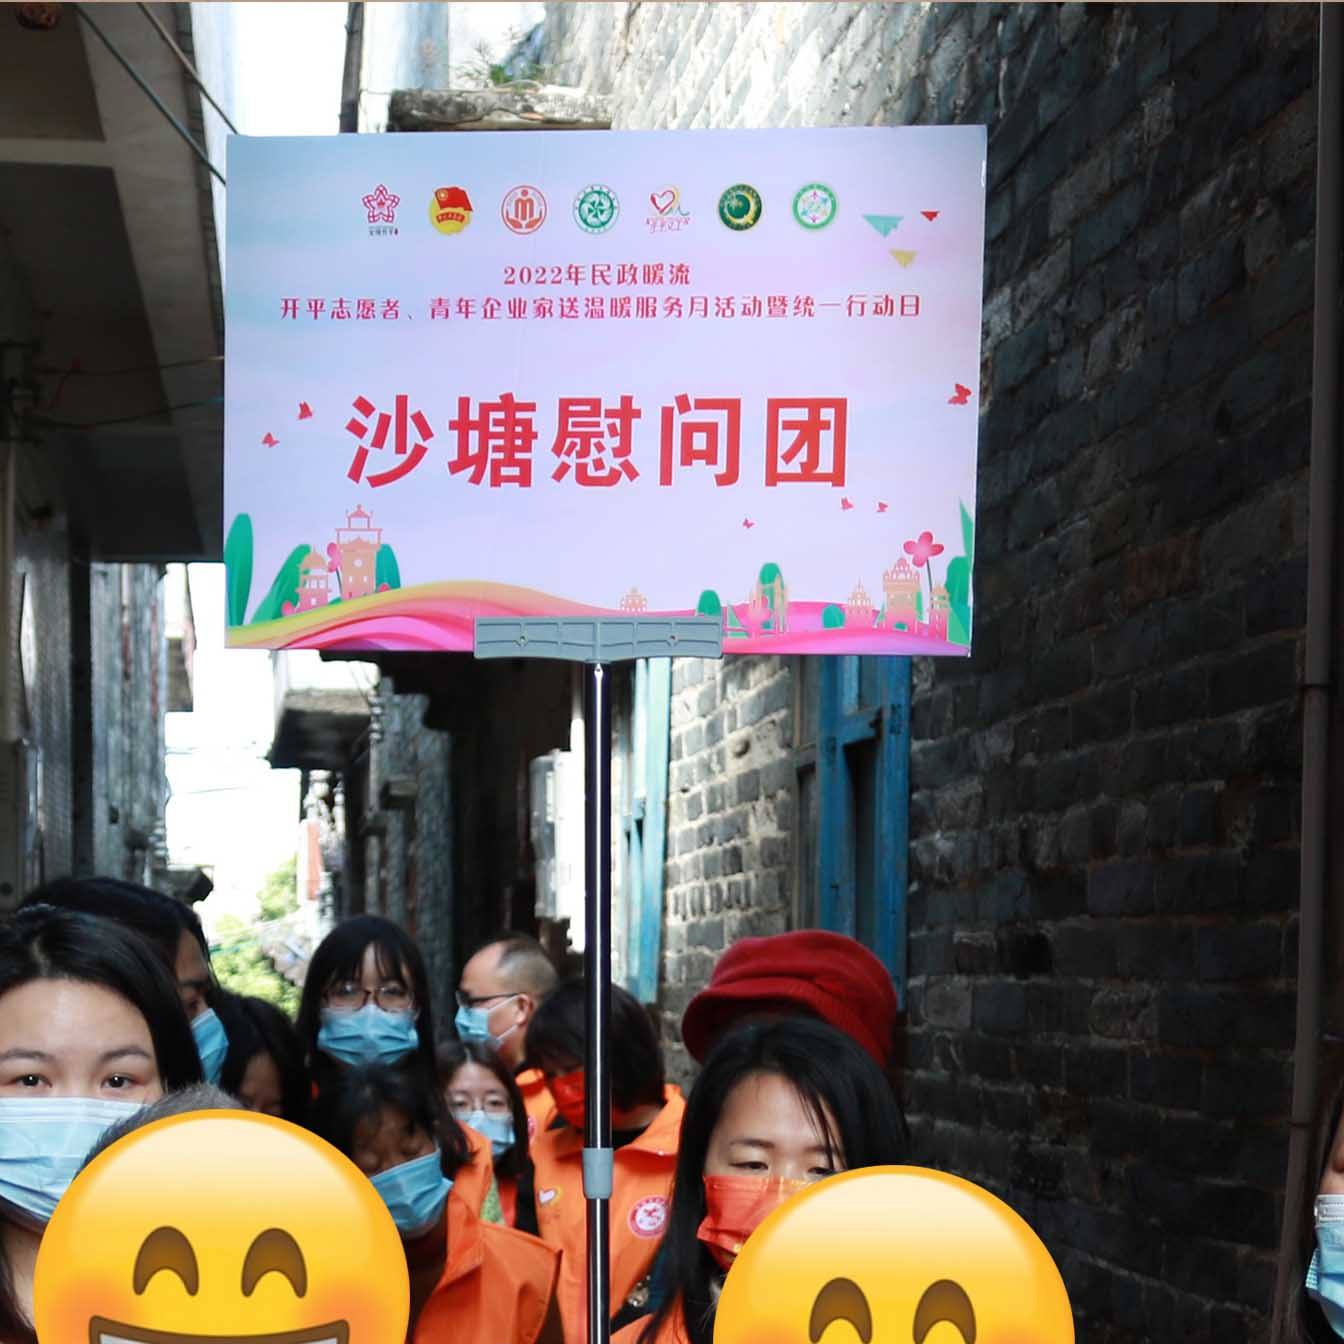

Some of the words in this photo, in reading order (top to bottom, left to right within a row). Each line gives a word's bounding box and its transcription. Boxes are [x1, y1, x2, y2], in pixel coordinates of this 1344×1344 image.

[503, 263, 691, 286] 2022年民政暖流
[280, 294, 921, 320] 开平志愿者、青年企业家送温暖服务月活动暨统一行动日
[344, 391, 849, 489] 沙塘慰问团
